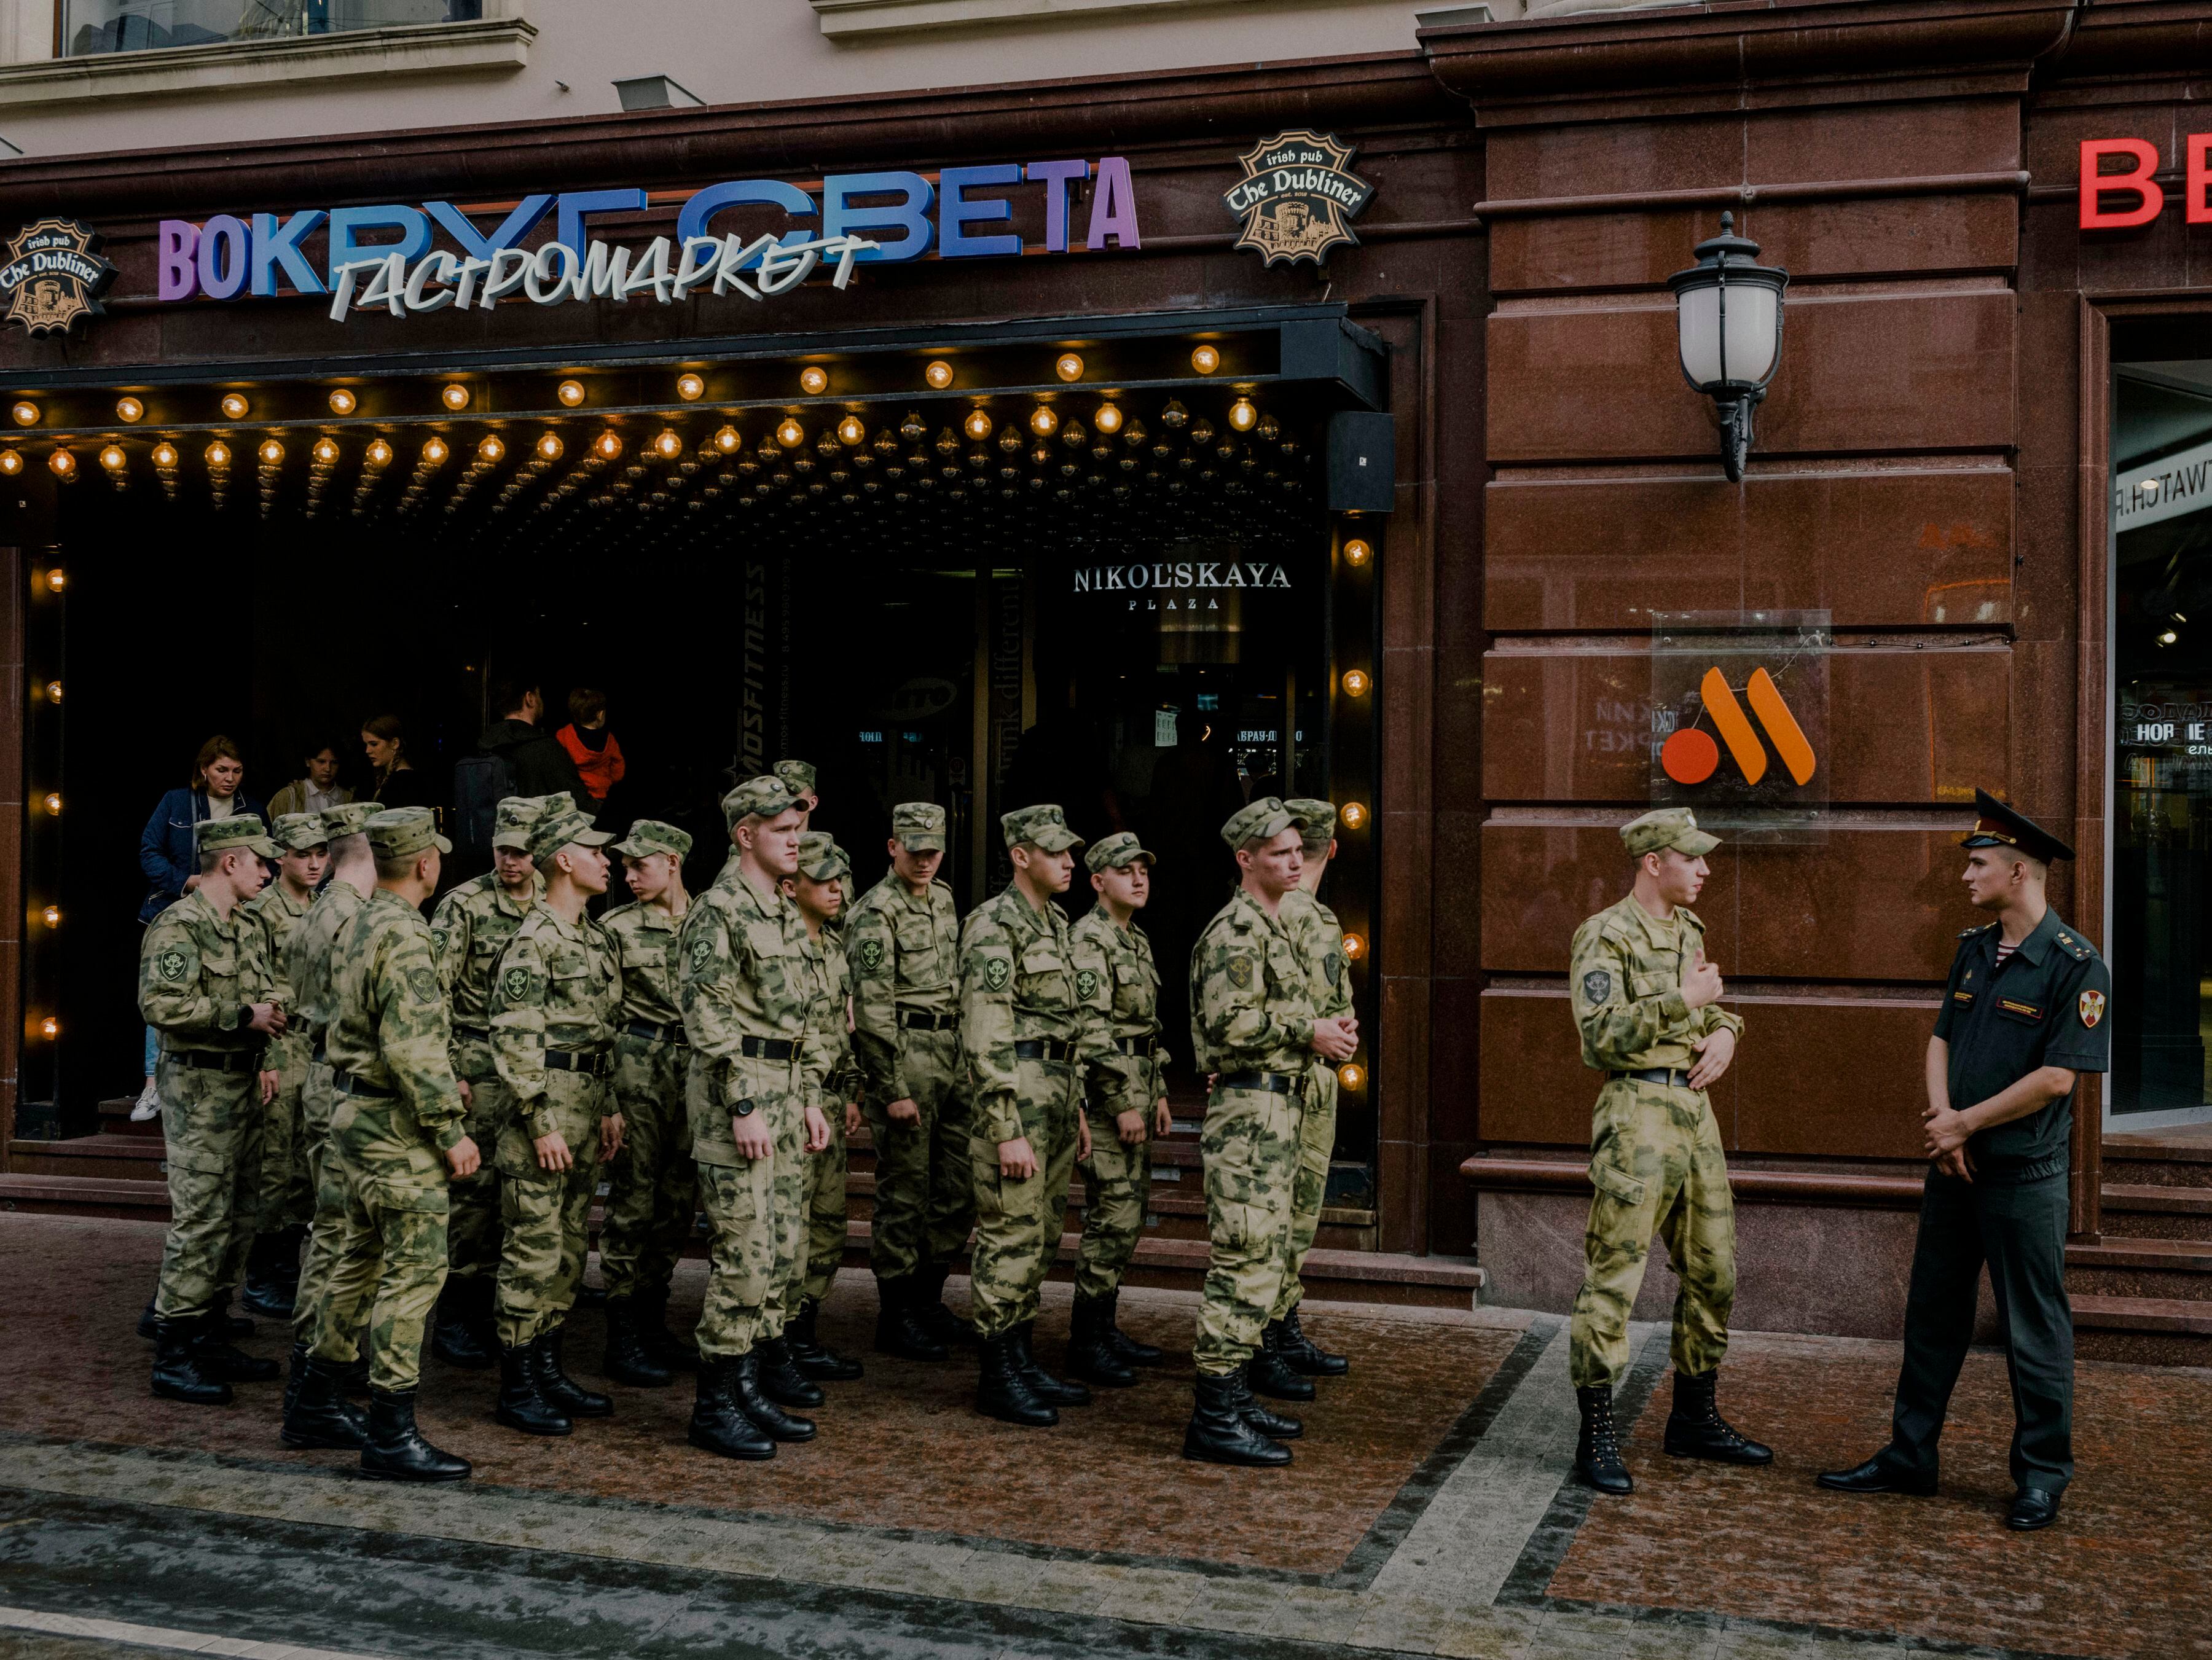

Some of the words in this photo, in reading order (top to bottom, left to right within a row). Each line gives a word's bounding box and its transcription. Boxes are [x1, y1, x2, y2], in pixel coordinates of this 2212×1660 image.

[1266, 150, 1295, 166] irish
[1301, 150, 1323, 163] pub
[1227, 181, 1268, 210] The
[1273, 169, 1362, 206] Dubliner
[27, 236, 50, 249] irish
[52, 236, 70, 248] pub
[159, 188, 648, 301] ВОКРУГ
[677, 156, 1140, 273] СВЕТА
[0, 264, 30, 288] The
[32, 251, 99, 283] Dubliner
[330, 232, 880, 322] ГАСТРОМАРКЕТ
[1128, 598, 1219, 611] PLAZA
[992, 583, 1020, 700] different
